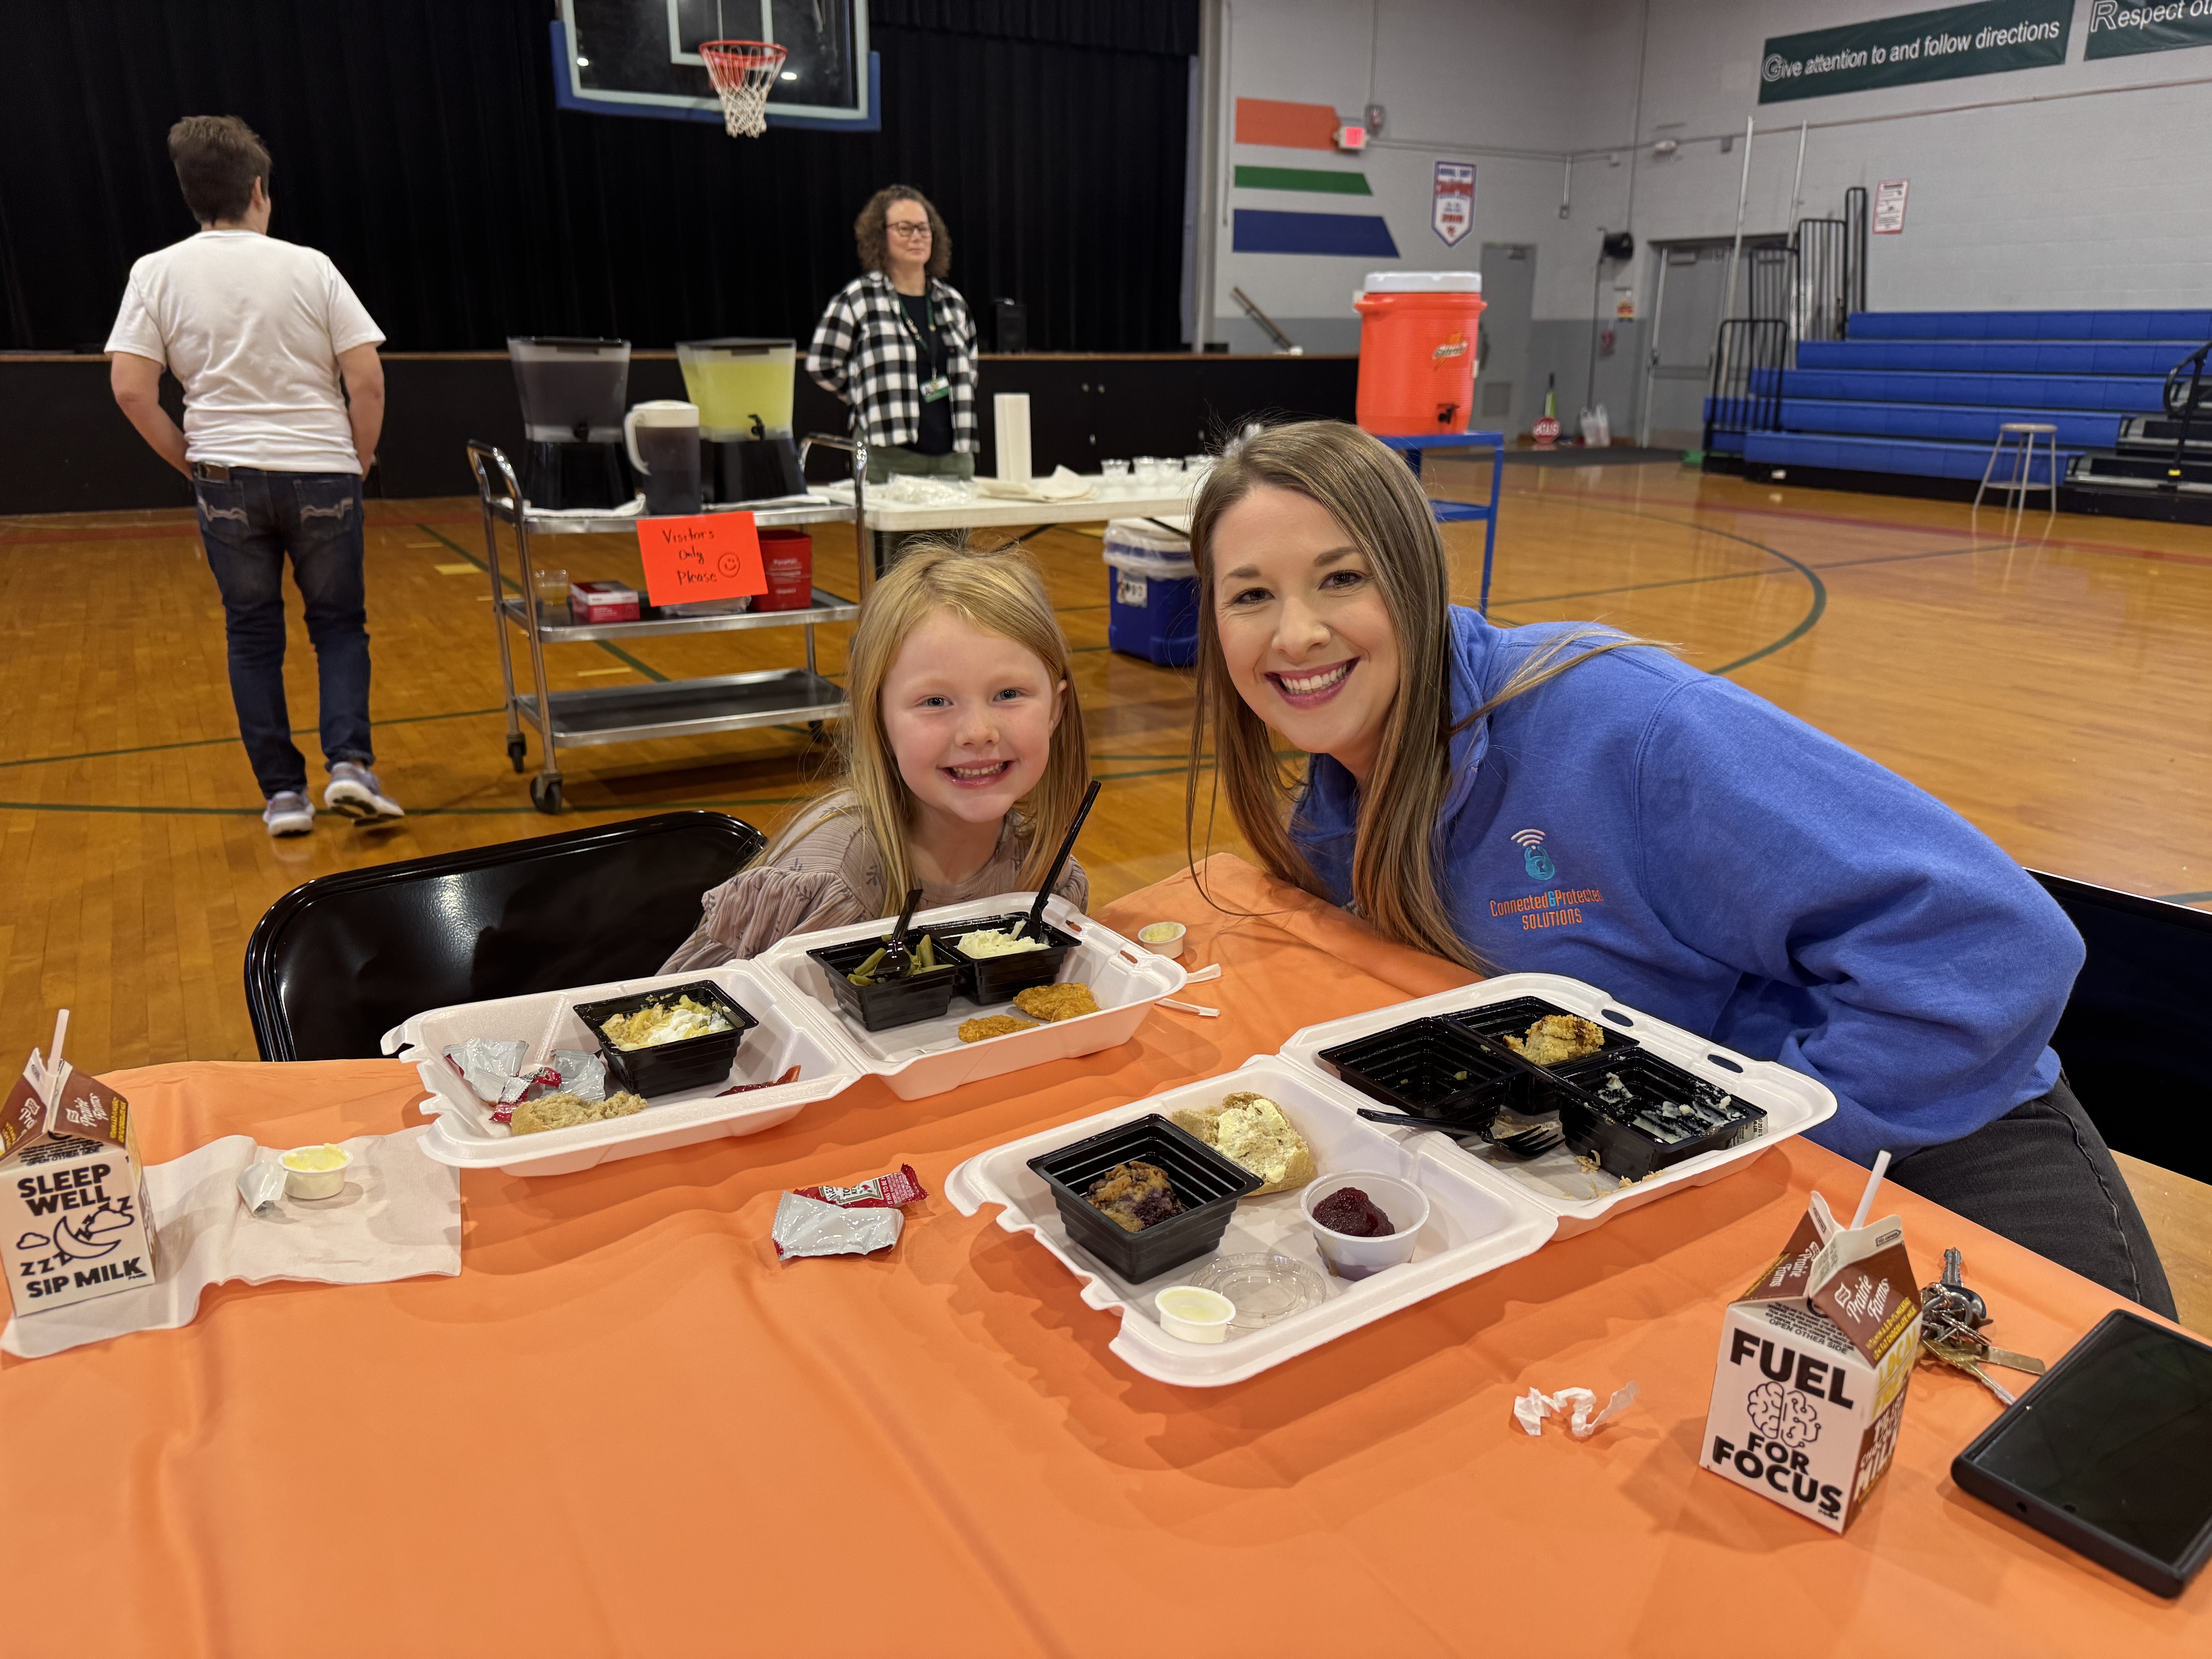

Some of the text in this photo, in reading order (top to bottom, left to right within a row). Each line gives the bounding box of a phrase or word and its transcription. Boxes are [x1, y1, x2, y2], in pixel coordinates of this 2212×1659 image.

[2091, 0, 2185, 33] Respect
[1761, 20, 2060, 82] Give attention to and follow directions
[662, 528, 714, 544] Visitors
[677, 570, 718, 586] Please
[1522, 908, 1582, 930] SOLUTIONS
[17, 1163, 111, 1198] SLEEP
[25, 1185, 111, 1216] WELL
[26, 1257, 144, 1298] SIP MILK
[1769, 1263, 1792, 1287] Farms
[1790, 1248, 1812, 1277] Prairie
[1846, 1275, 1872, 1324] Prairie
[1867, 1278, 1890, 1324] Farms
[1769, 1317, 1848, 1354] OPEN OTHER SIDE
[1886, 1315, 1909, 1345] CHOCOLATE
[1906, 1305, 1918, 1321] MILK
[1730, 1328, 1854, 1410] FUEL
[1747, 1431, 1810, 1475] FOR
[1712, 1435, 1844, 1513] FOCUS
